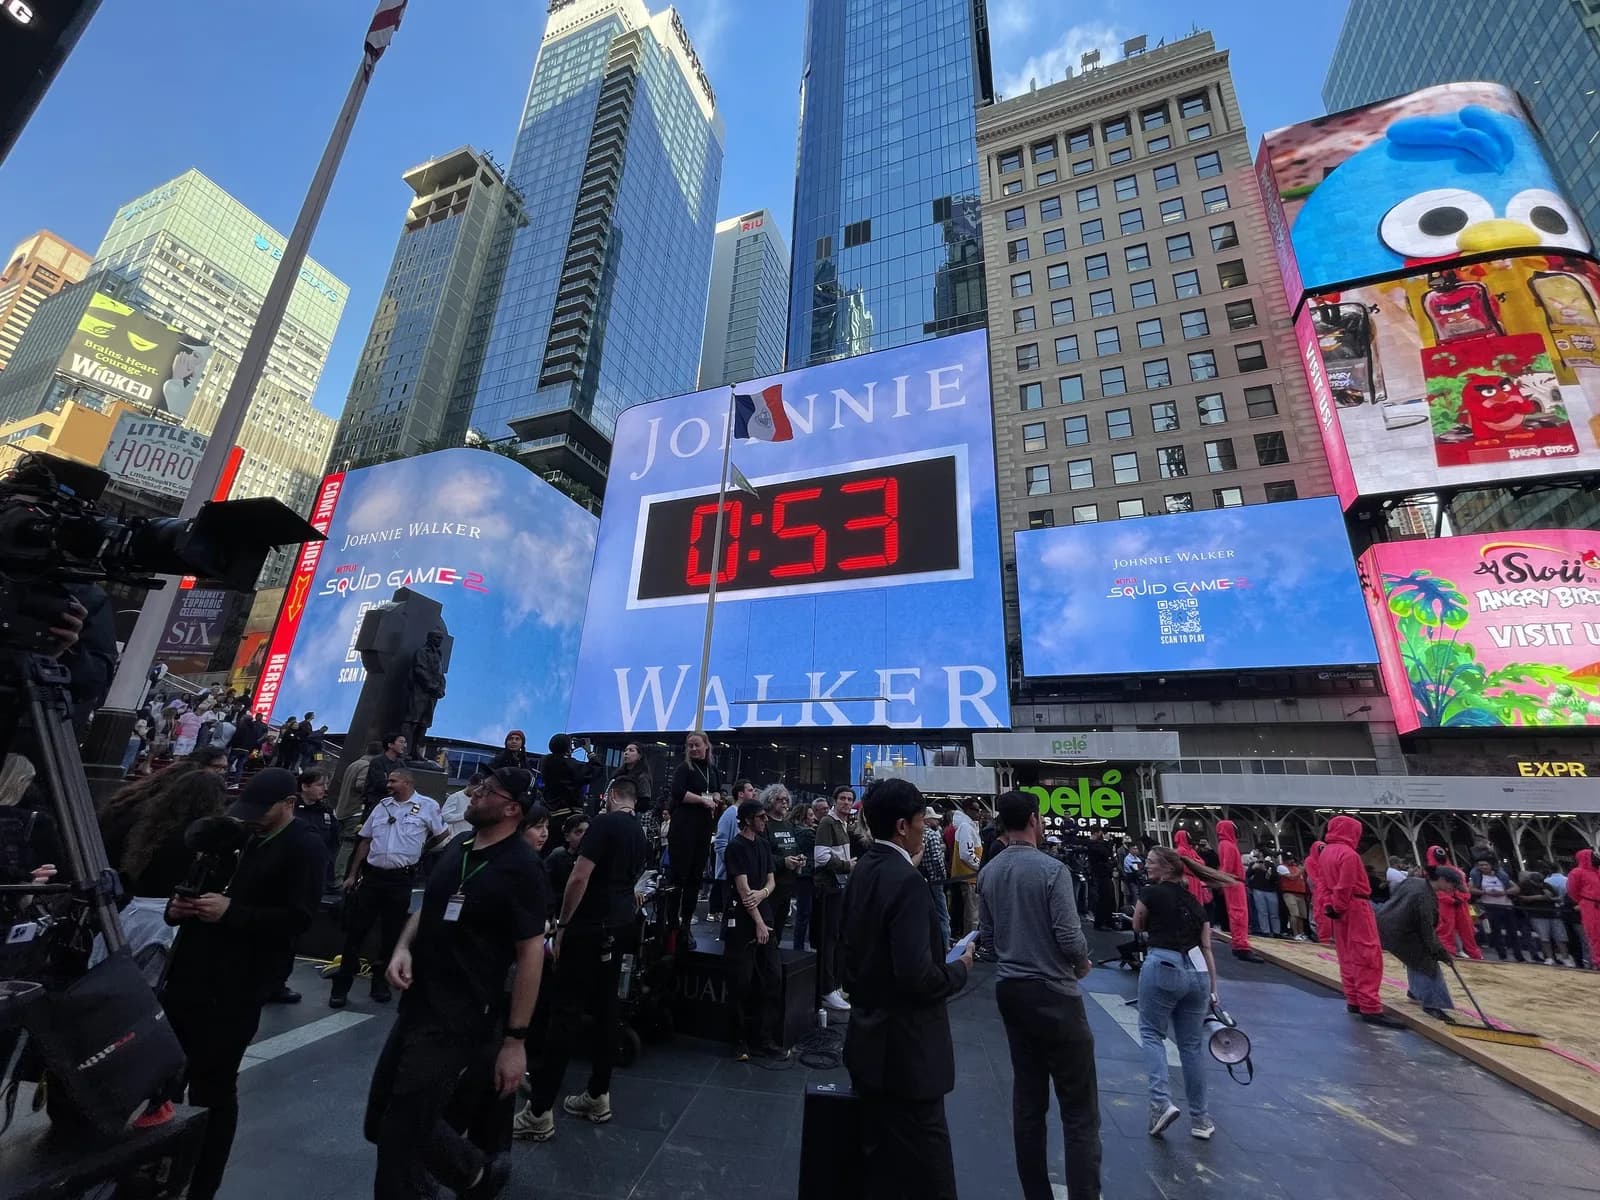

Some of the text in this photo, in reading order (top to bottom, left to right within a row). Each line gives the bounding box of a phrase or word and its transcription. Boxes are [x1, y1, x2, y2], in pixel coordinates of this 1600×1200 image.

[742, 219, 764, 232] RIU
[270, 247, 338, 304] BCLAYS
[83, 339, 159, 376] Brains. Heart.
[95, 352, 143, 377] Courage.
[1305, 340, 1323, 392] VISIT
[127, 423, 189, 444] LITTLE
[630, 363, 966, 481] JONNIE
[115, 438, 200, 481] HORRO
[1509, 443, 1575, 460] ANGRY BIRDS
[316, 481, 340, 520] COME
[341, 521, 481, 552] JOHNNIE WALKER
[685, 475, 899, 588] 0:53
[1112, 549, 1236, 570] JOHNNIE WALKER
[318, 566, 490, 598] SQUID GAME 2
[1106, 579, 1168, 600] SQUID
[1172, 578, 1235, 597] GAME
[1473, 588, 1550, 613] ANGRY
[1160, 633, 1206, 645] SCAN TO PLAY
[1485, 622, 1574, 649] VISIT
[338, 667, 360, 683] SCAN
[613, 664, 1001, 731] WALKER
[1517, 761, 1588, 777] EXPR
